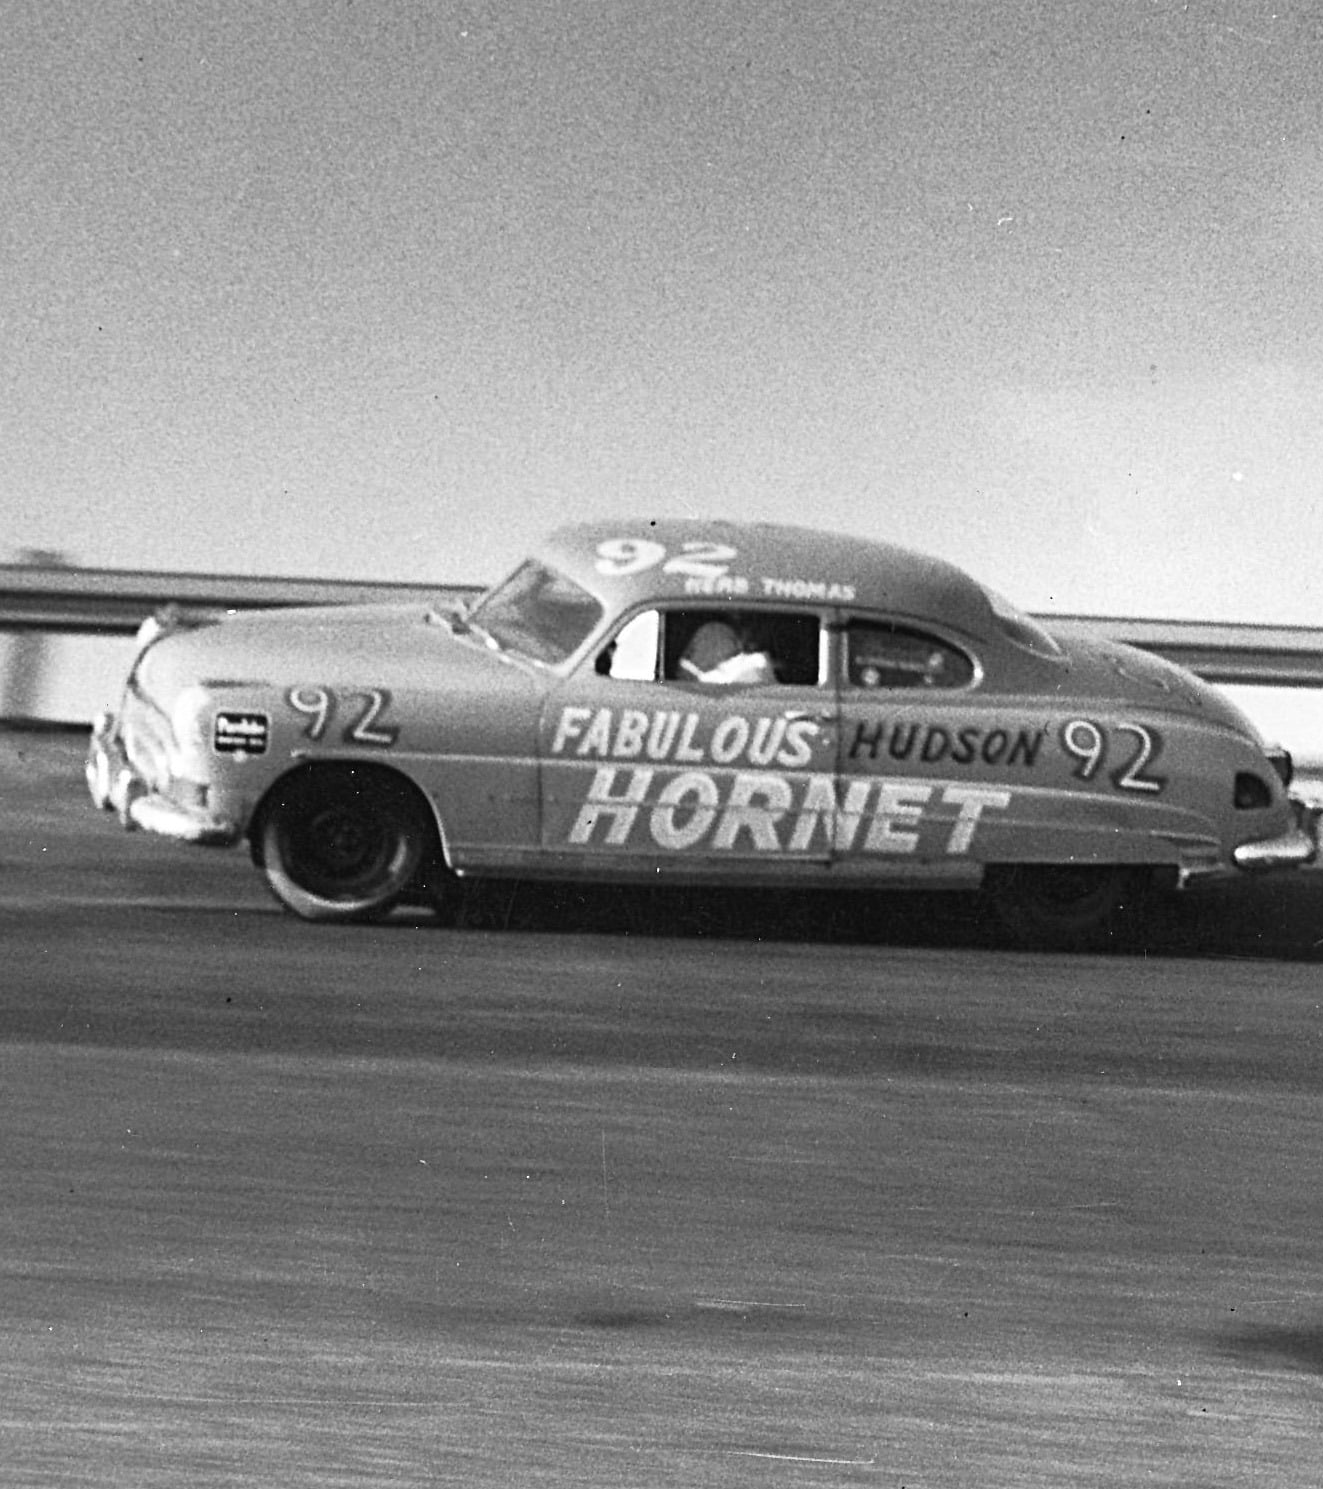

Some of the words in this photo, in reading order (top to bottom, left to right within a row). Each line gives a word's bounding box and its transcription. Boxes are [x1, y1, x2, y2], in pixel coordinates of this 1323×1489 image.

[594, 538, 738, 575] 92
[760, 576, 857, 600] THOMAS
[287, 685, 395, 744] 92
[552, 707, 818, 767] FABULOUS
[848, 721, 1043, 767] HUDSON
[1063, 719, 1162, 791] 92
[567, 767, 1012, 855] HORNET
